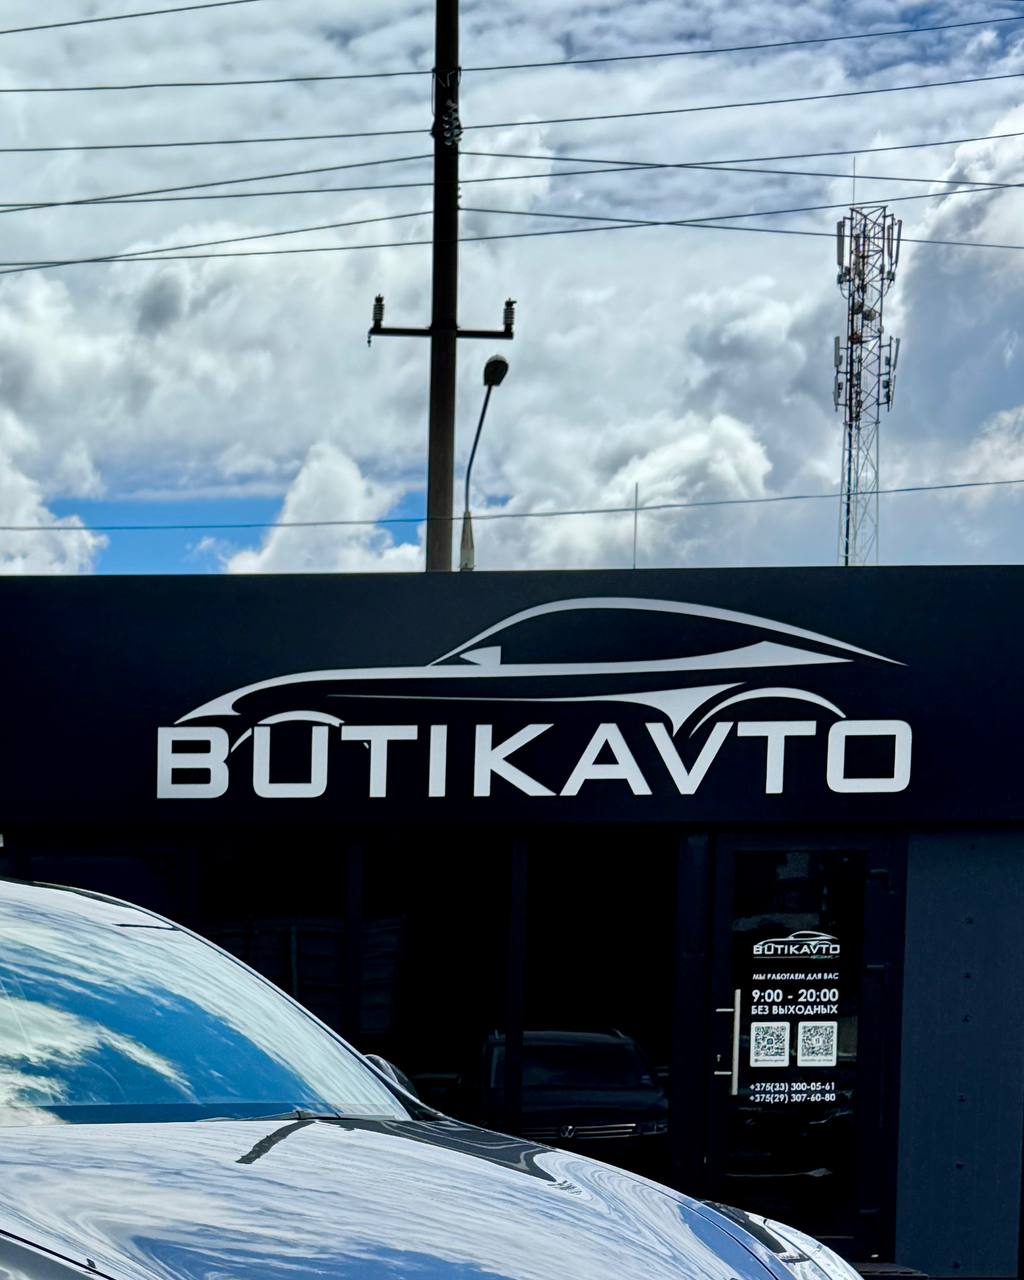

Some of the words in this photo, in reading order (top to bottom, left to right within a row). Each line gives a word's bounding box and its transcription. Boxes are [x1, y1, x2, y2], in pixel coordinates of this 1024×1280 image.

[156, 719, 913, 799] BUTIKAVTO
[752, 943, 841, 955] BUTIKAVTO
[806, 973, 822, 981] ДЛЯ
[823, 972, 839, 980] ВАС
[751, 989, 783, 1003] 9:00
[798, 988, 839, 1003] 20:00
[751, 1005, 769, 1015] БЕЗ
[772, 1004, 839, 1016] ВЫХОДНЫХ
[790, 1081, 835, 1091] 300-05-61
[790, 1093, 836, 1102] 307-60-80
